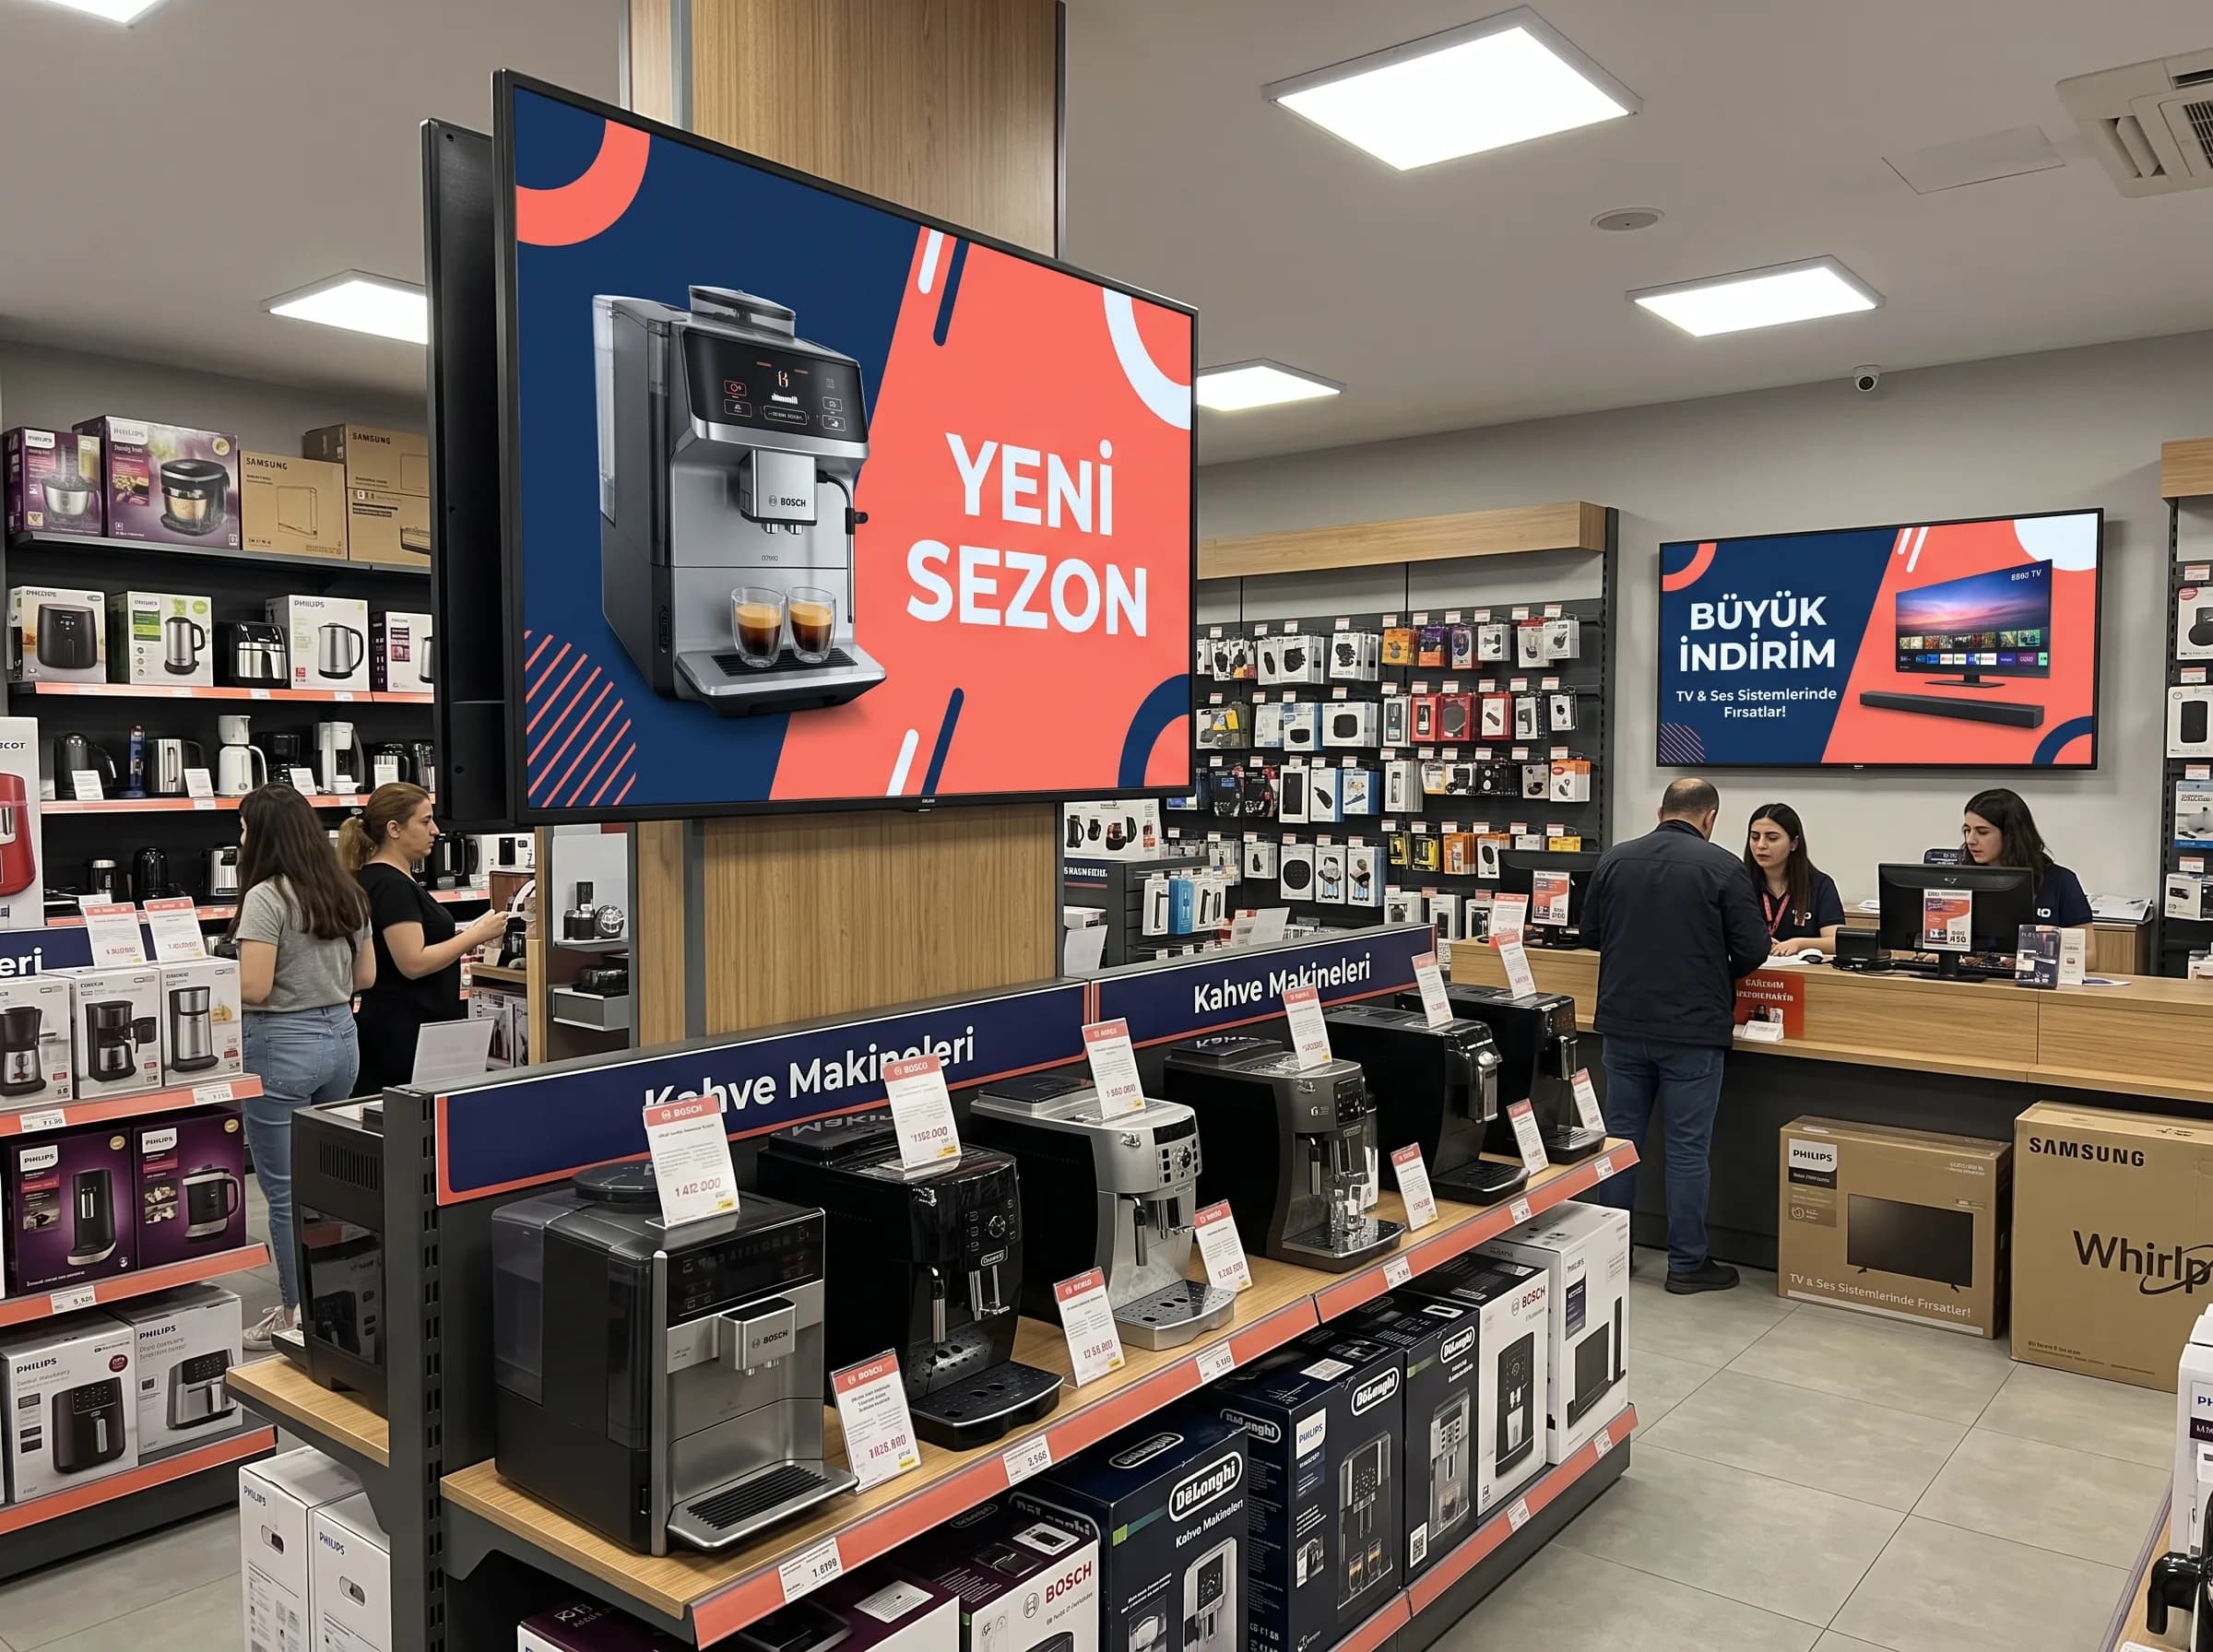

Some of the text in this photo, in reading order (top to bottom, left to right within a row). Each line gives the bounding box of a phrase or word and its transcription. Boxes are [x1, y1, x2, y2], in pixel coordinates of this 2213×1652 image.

[352, 432, 391, 444] SAMSUNG
[246, 457, 288, 470] SAMSUNG
[780, 497, 807, 508] BOSCH
[906, 538, 1148, 637] SEZON
[1690, 590, 1827, 631] BÜYÜK
[1679, 631, 1836, 672] İNDİRİM
[1675, 687, 1838, 702] TV & Ses Sistemlerinde
[1723, 704, 1786, 718] Fırsatlar!
[1194, 952, 1370, 1013] Kahve Makineleri
[24, 1151, 54, 1165] PHILIPS
[1793, 1148, 1833, 1162] PHILIPS
[2029, 1137, 2146, 1167] SAMSUNG
[1521, 1285, 1545, 1309] BOSCH
[1789, 1273, 1805, 1284] TV
[1817, 1279, 1836, 1291] Ses
[1838, 1282, 1915, 1306] Sistemlerinde
[139, 1324, 177, 1340] PHILIPS
[763, 1329, 788, 1346] BOSCH
[17, 1356, 57, 1375] PHILIPS
[1046, 1560, 1093, 1605] BOSCH
